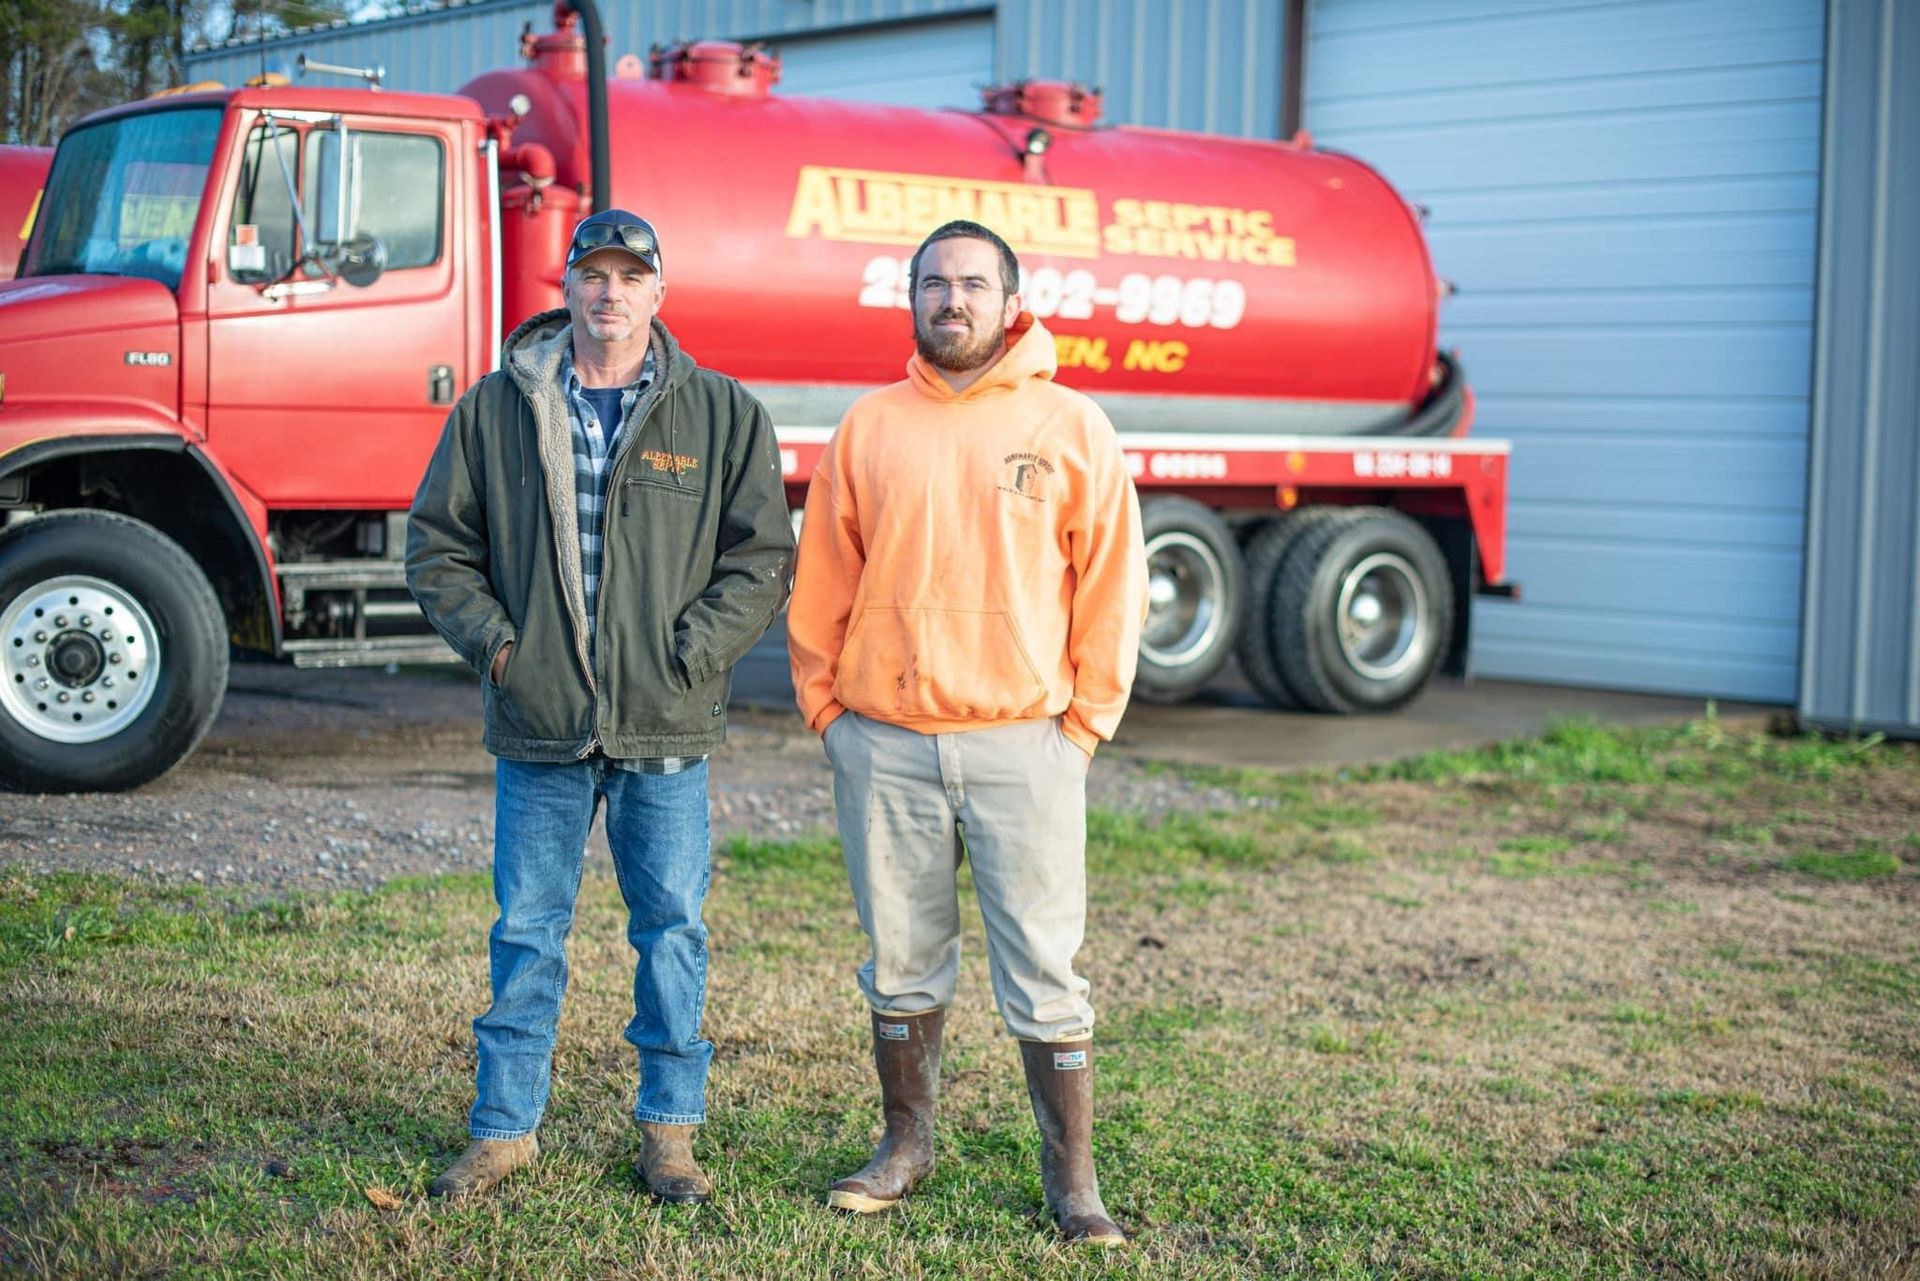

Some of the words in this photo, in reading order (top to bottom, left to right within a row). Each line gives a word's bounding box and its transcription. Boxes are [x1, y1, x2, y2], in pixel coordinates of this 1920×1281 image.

[786, 164, 1099, 258] ALBEMARLE
[1113, 198, 1276, 240] SEPTIC
[1102, 224, 1297, 267] SERVICE
[1123, 339, 1190, 373] NC
